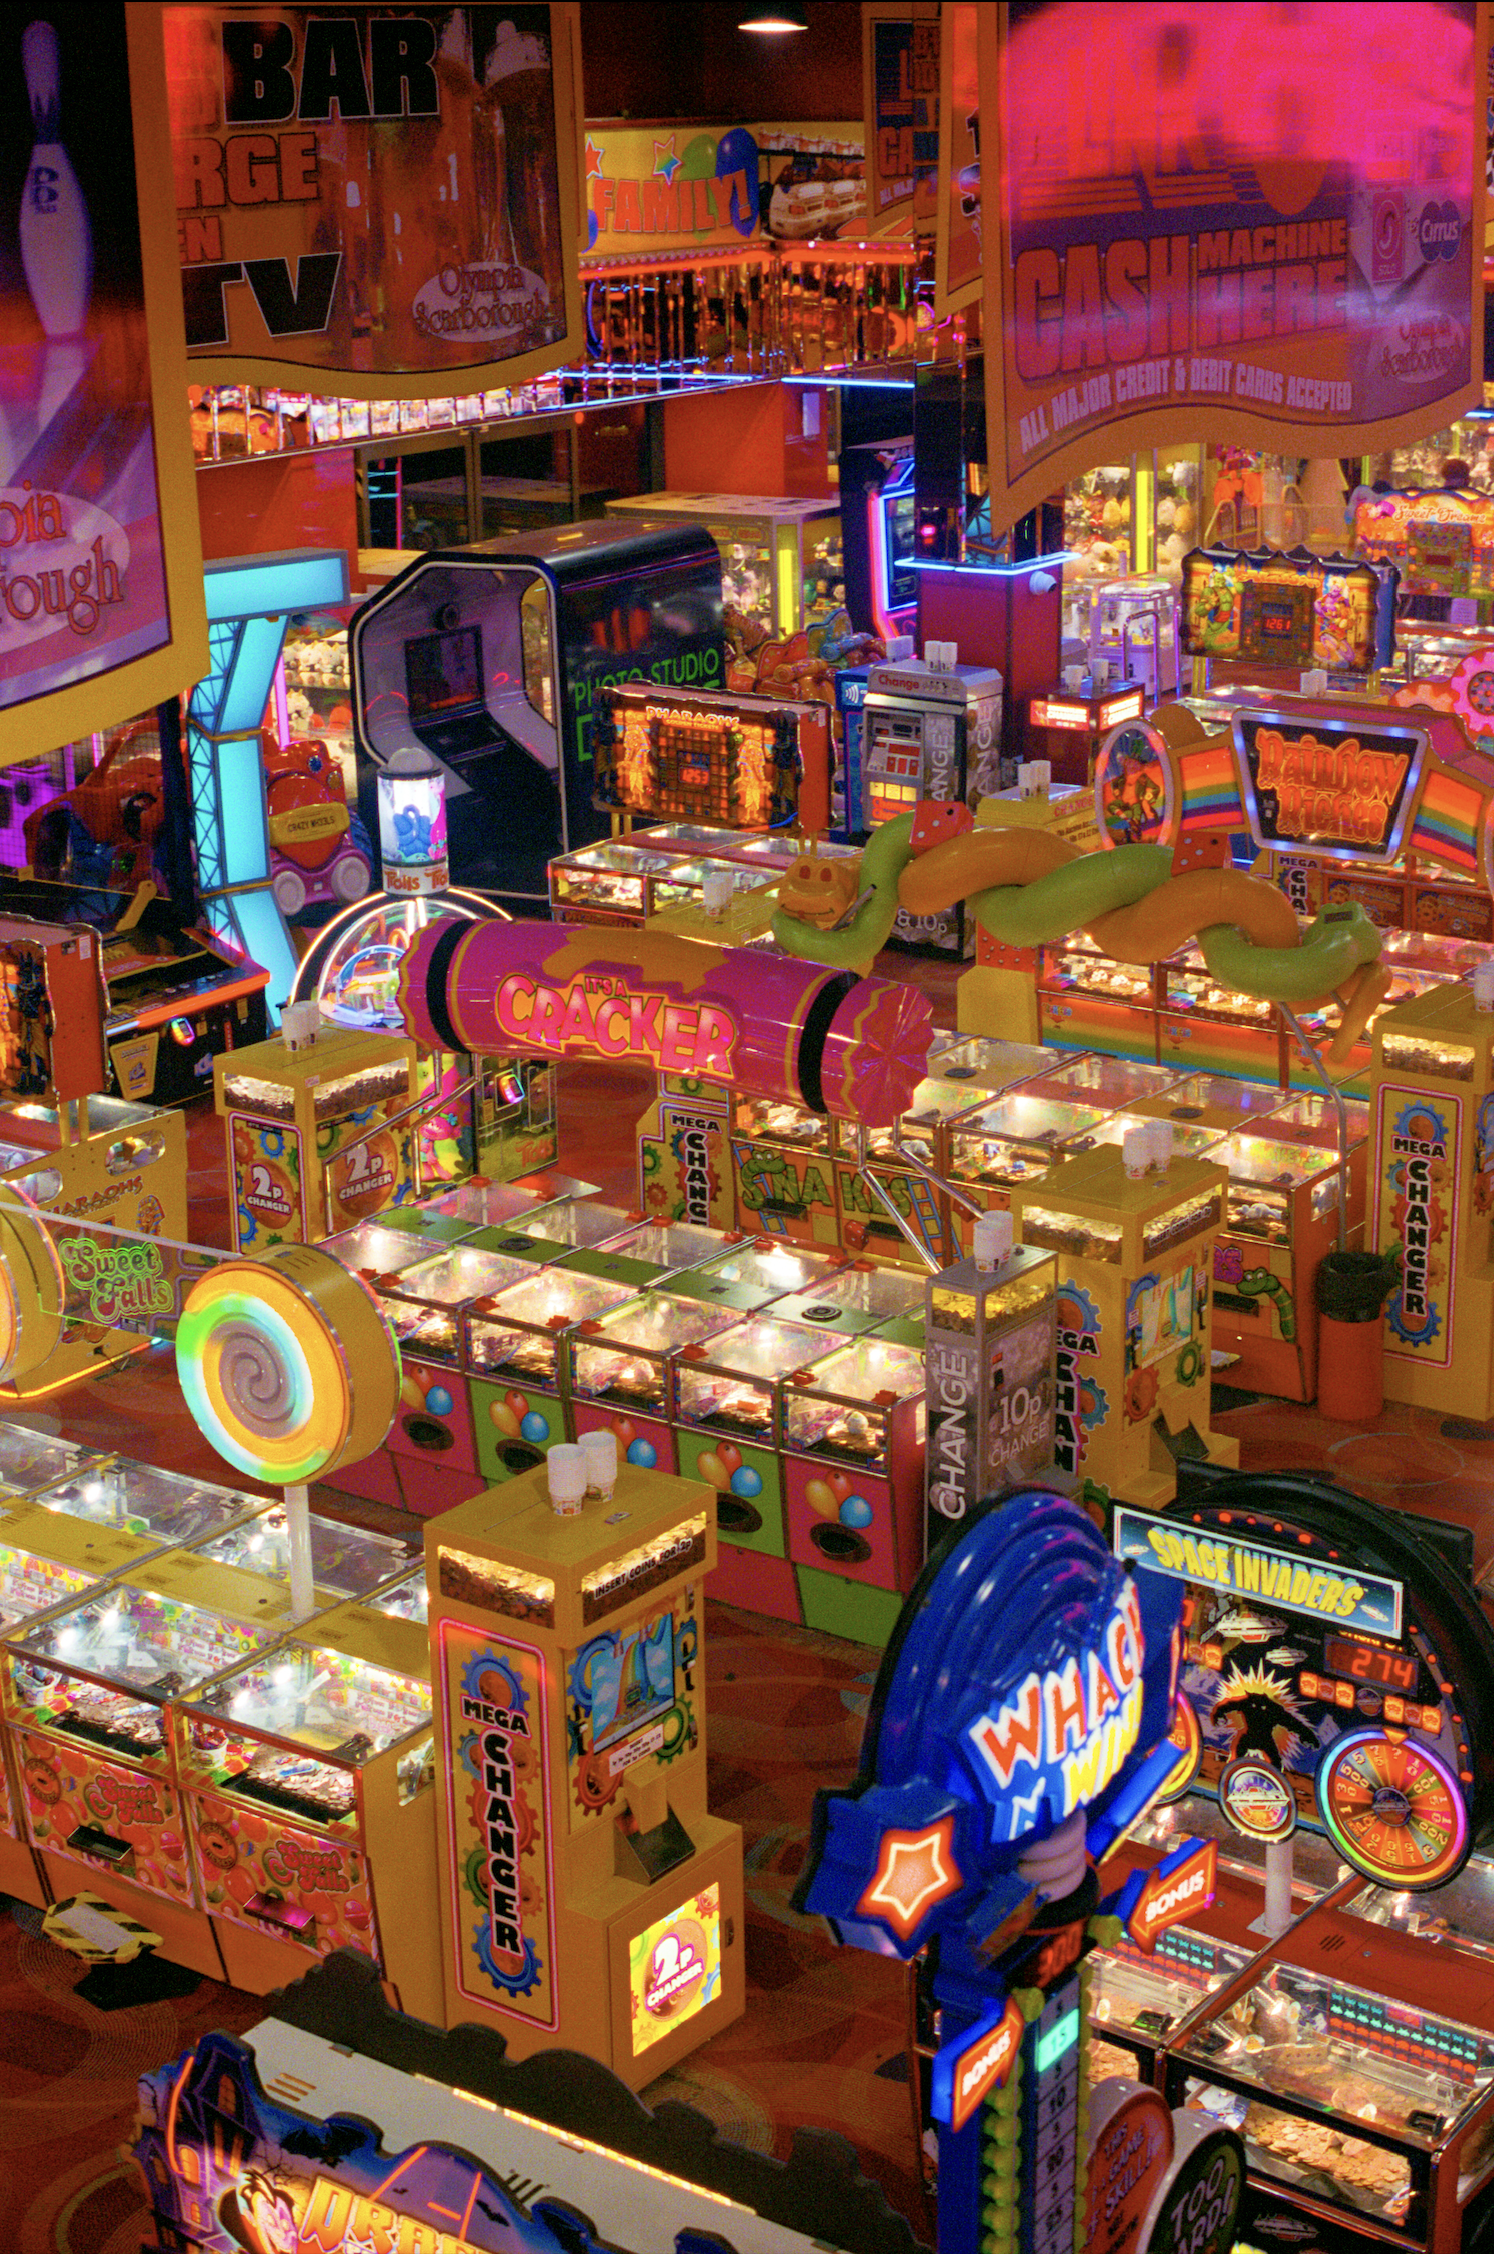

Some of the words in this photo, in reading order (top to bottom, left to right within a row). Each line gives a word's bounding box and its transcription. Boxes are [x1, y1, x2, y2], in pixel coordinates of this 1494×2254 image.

[221, 18, 440, 125] BAR
[592, 168, 752, 233] FAMILY!
[1199, 219, 1348, 272] MACHINE
[1421, 219, 1459, 244] Cirrus
[438, 262, 525, 306] Olympia
[1199, 258, 1348, 348] HERE
[413, 287, 546, 336] Scarborough
[1013, 235, 1191, 385] CASH
[1019, 404, 1050, 454] ALL
[1051, 373, 1112, 431] MAJOR
[1115, 359, 1170, 402] CREDIT
[1174, 358, 1187, 391] &
[1190, 358, 1233, 392] DEBIT
[1235, 363, 1284, 404] CARDS
[1286, 375, 1352, 411] ACCEPTED
[0, 535, 124, 635] ough
[1266, 618, 1291, 630] 1261
[651, 648, 719, 685] STUDIO
[878, 674, 920, 690] Change
[646, 705, 740, 732] PHARAOHS
[1256, 728, 1409, 804] Rainbow
[1277, 785, 1388, 844] Riches
[384, 870, 421, 891] Trolls
[1279, 855, 1319, 868] MEGA
[585, 976, 613, 996] IT'S
[615, 978, 628, 998] A
[497, 973, 738, 1078] CRACKER
[671, 1113, 722, 1133] MEGA
[1393, 1136, 1447, 1160] MEGA
[247, 1195, 291, 1216] CHANGER
[338, 1171, 394, 1201] CHANGER
[1405, 1157, 1432, 1317] CHANGER
[61, 1240, 162, 1288] Sweet
[93, 1276, 173, 1321] Falls
[1000, 1386, 1042, 1435] 10p
[938, 1350, 967, 1520] CHANGE
[988, 1419, 1049, 1467] CHANGE
[594, 1570, 628, 1600] INSERT
[628, 1555, 657, 1581] COINS
[659, 1544, 678, 1564] FOR
[1147, 1525, 1233, 1585] SPACE
[1233, 1547, 1365, 1617] INVADERS
[1351, 1648, 1414, 1688] 274
[462, 1696, 531, 1739] MEGA
[96, 1775, 157, 1804] Sweet
[117, 1800, 164, 1825] Falls
[277, 1841, 343, 1870] Sweet
[480, 1729, 524, 1957] CHANGER
[298, 1866, 349, 1893] Falls
[1145, 1868, 1206, 1924] BONUS
[646, 1960, 703, 2010] CHANGER
[961, 2029, 1012, 2098] BONUS
[1170, 2157, 1225, 2243] TOO
